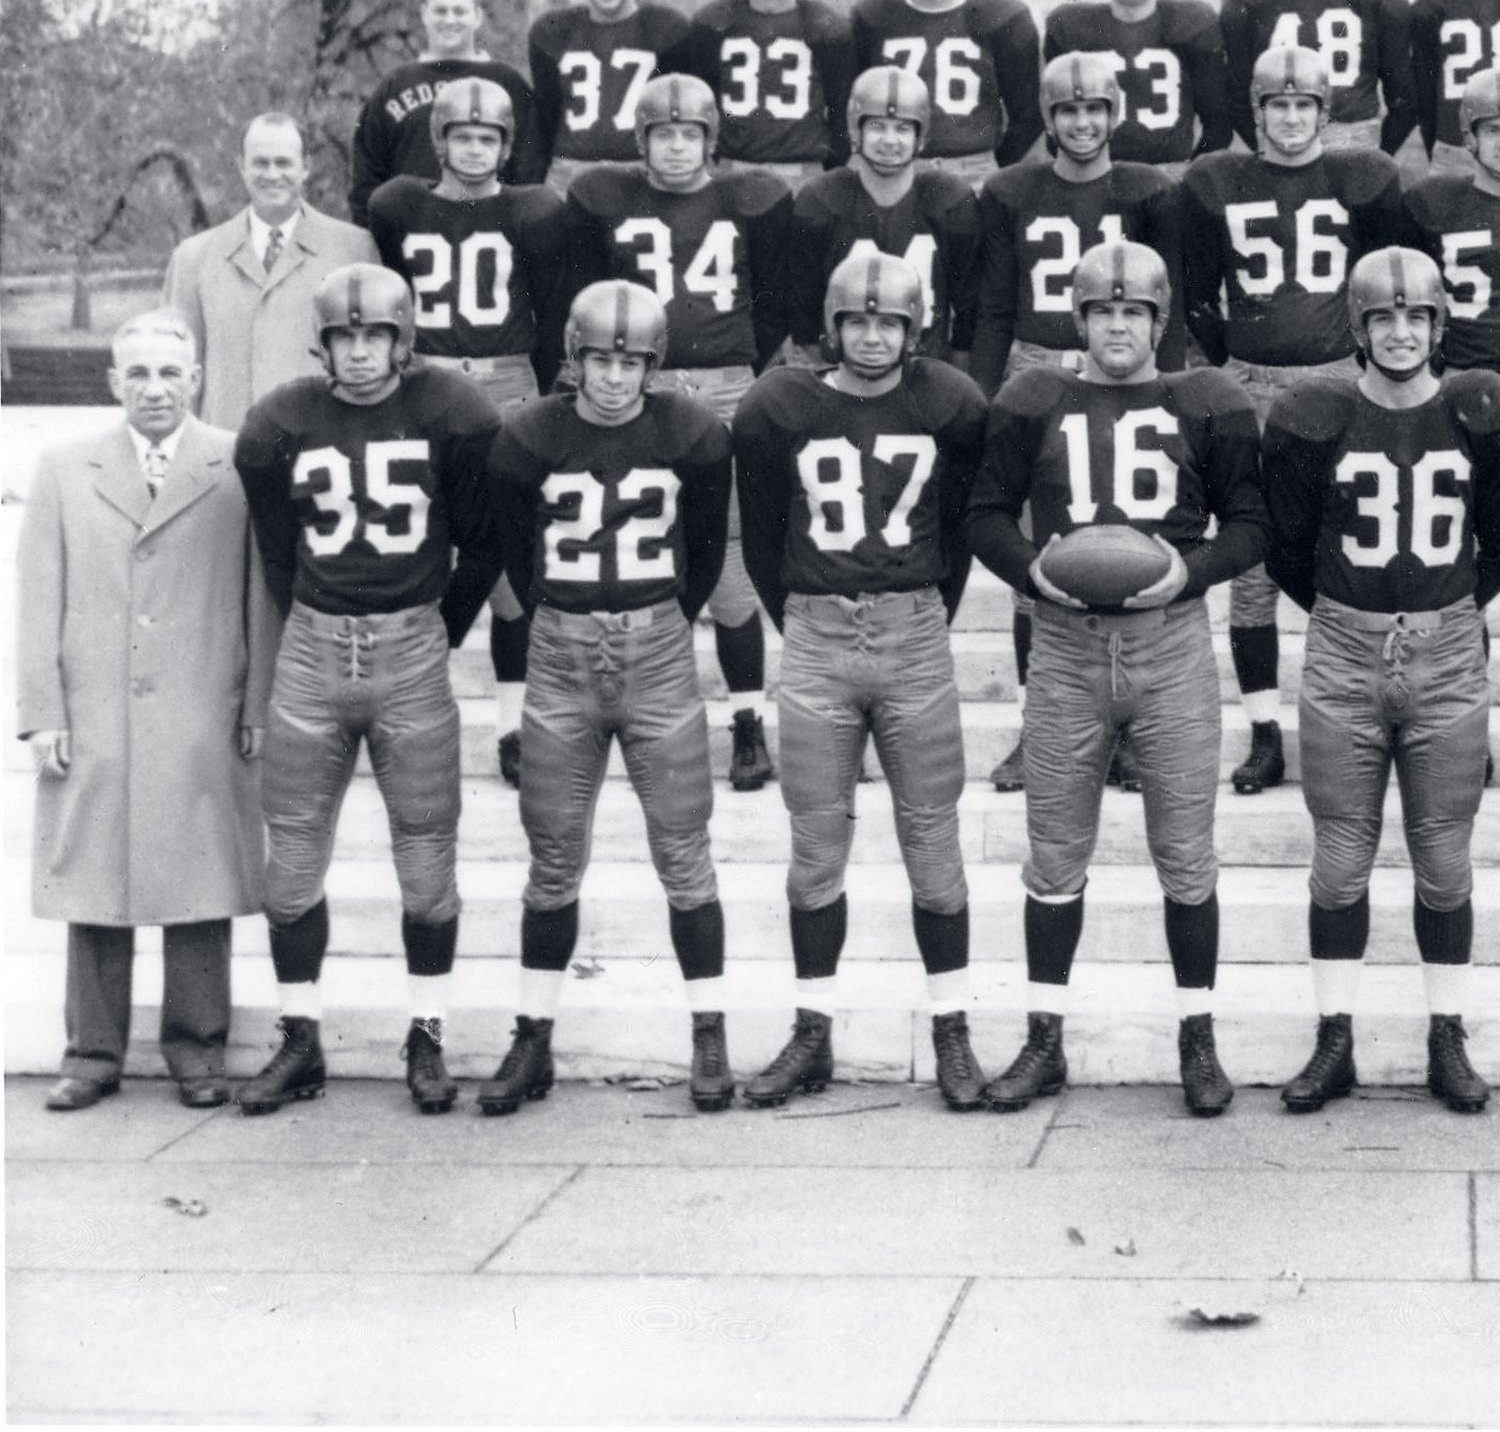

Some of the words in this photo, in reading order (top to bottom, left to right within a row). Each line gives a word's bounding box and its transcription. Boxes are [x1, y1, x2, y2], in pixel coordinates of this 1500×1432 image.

[559, 48, 657, 131] 37
[721, 37, 812, 119] 33
[402, 232, 513, 329] 20
[614, 217, 739, 312] 34
[1226, 198, 1349, 295] 56
[293, 439, 430, 557] 35
[798, 434, 937, 552] 87
[1059, 406, 1180, 523] 16
[1335, 450, 1472, 568] 36
[541, 467, 682, 582] 22
